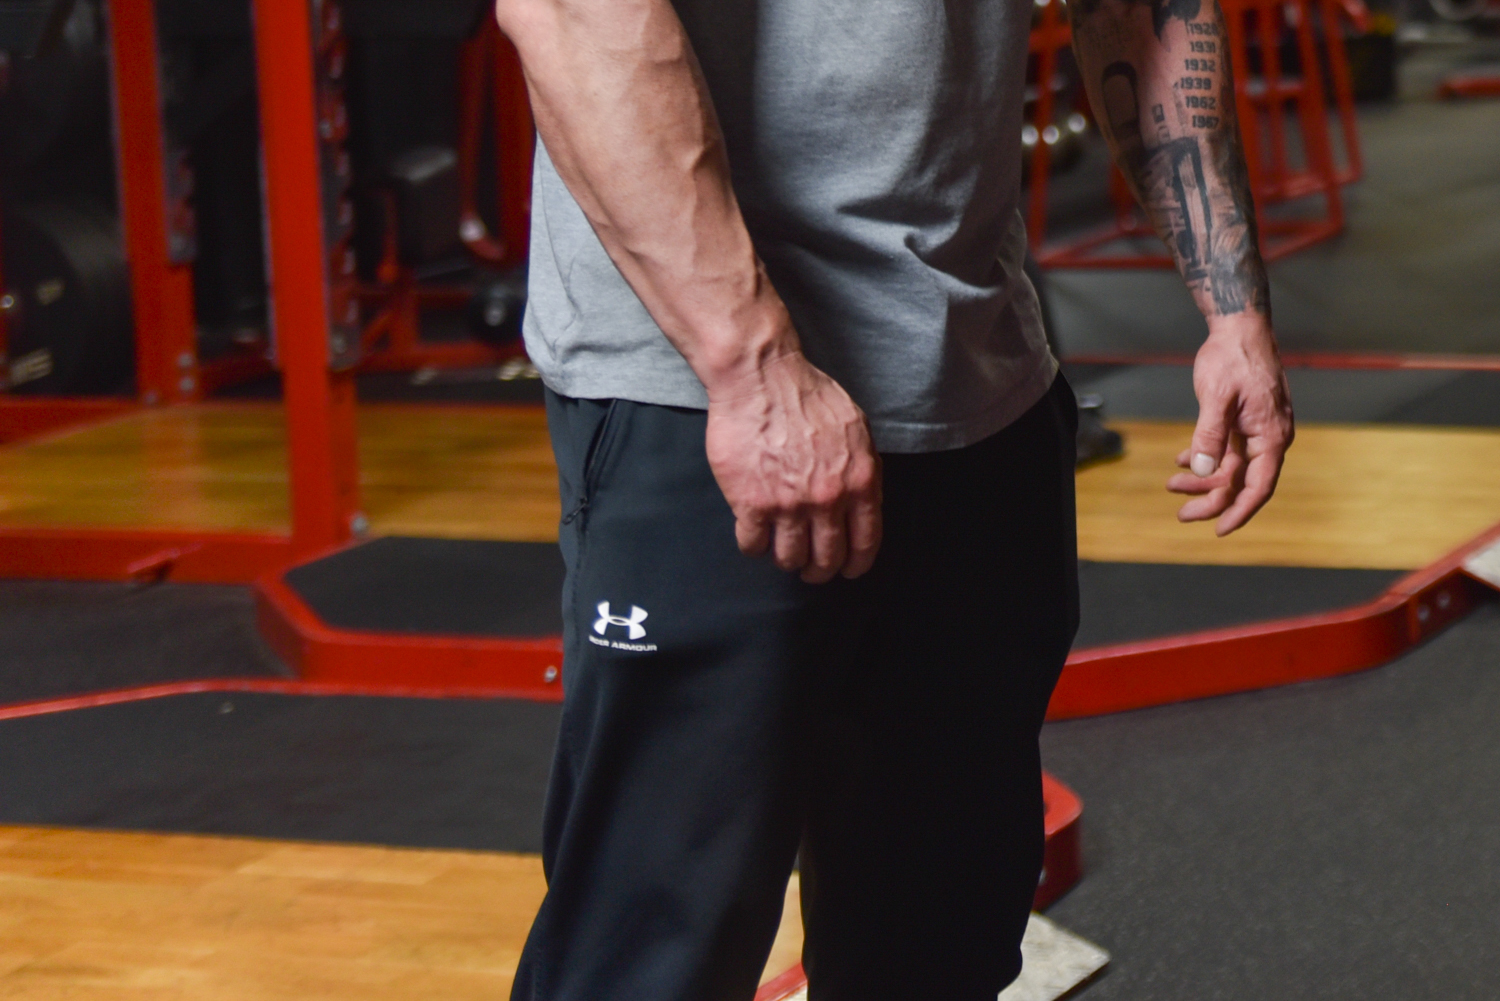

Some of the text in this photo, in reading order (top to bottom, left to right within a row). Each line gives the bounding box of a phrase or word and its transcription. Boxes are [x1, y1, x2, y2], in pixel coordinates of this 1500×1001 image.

[1190, 41, 1216, 53] 1931
[1184, 59, 1216, 71] 1932
[1180, 77, 1212, 90] 1939
[611, 641, 658, 652] ARMOUR
